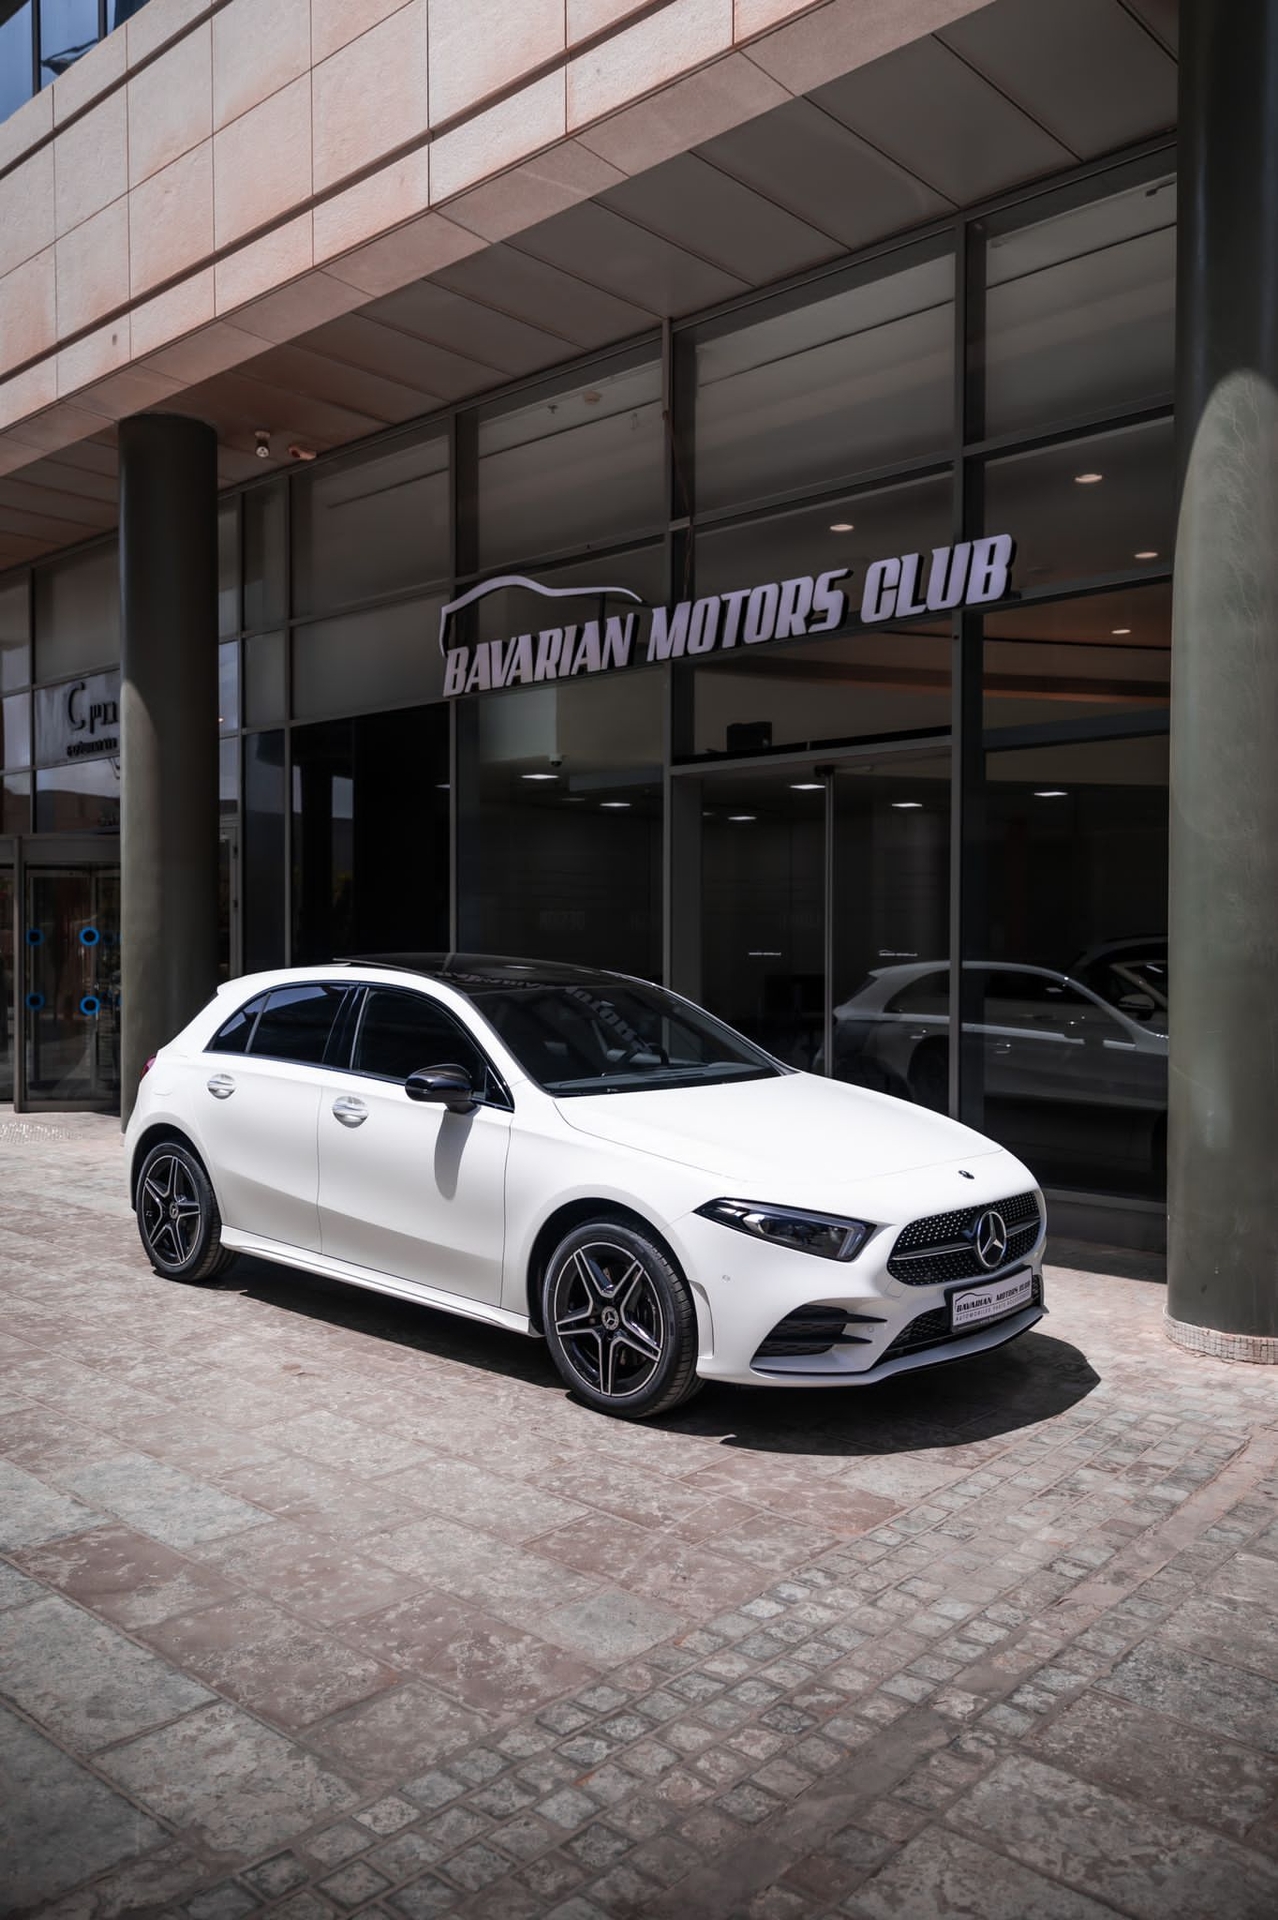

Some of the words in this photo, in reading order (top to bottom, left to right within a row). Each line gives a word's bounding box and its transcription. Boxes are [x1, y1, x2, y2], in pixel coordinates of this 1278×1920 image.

[443, 613, 634, 697] BAVARIAN
[647, 568, 850, 662] MOTORS
[861, 534, 1012, 623] CLUB
[956, 1297, 992, 1312] BAVARIAN
